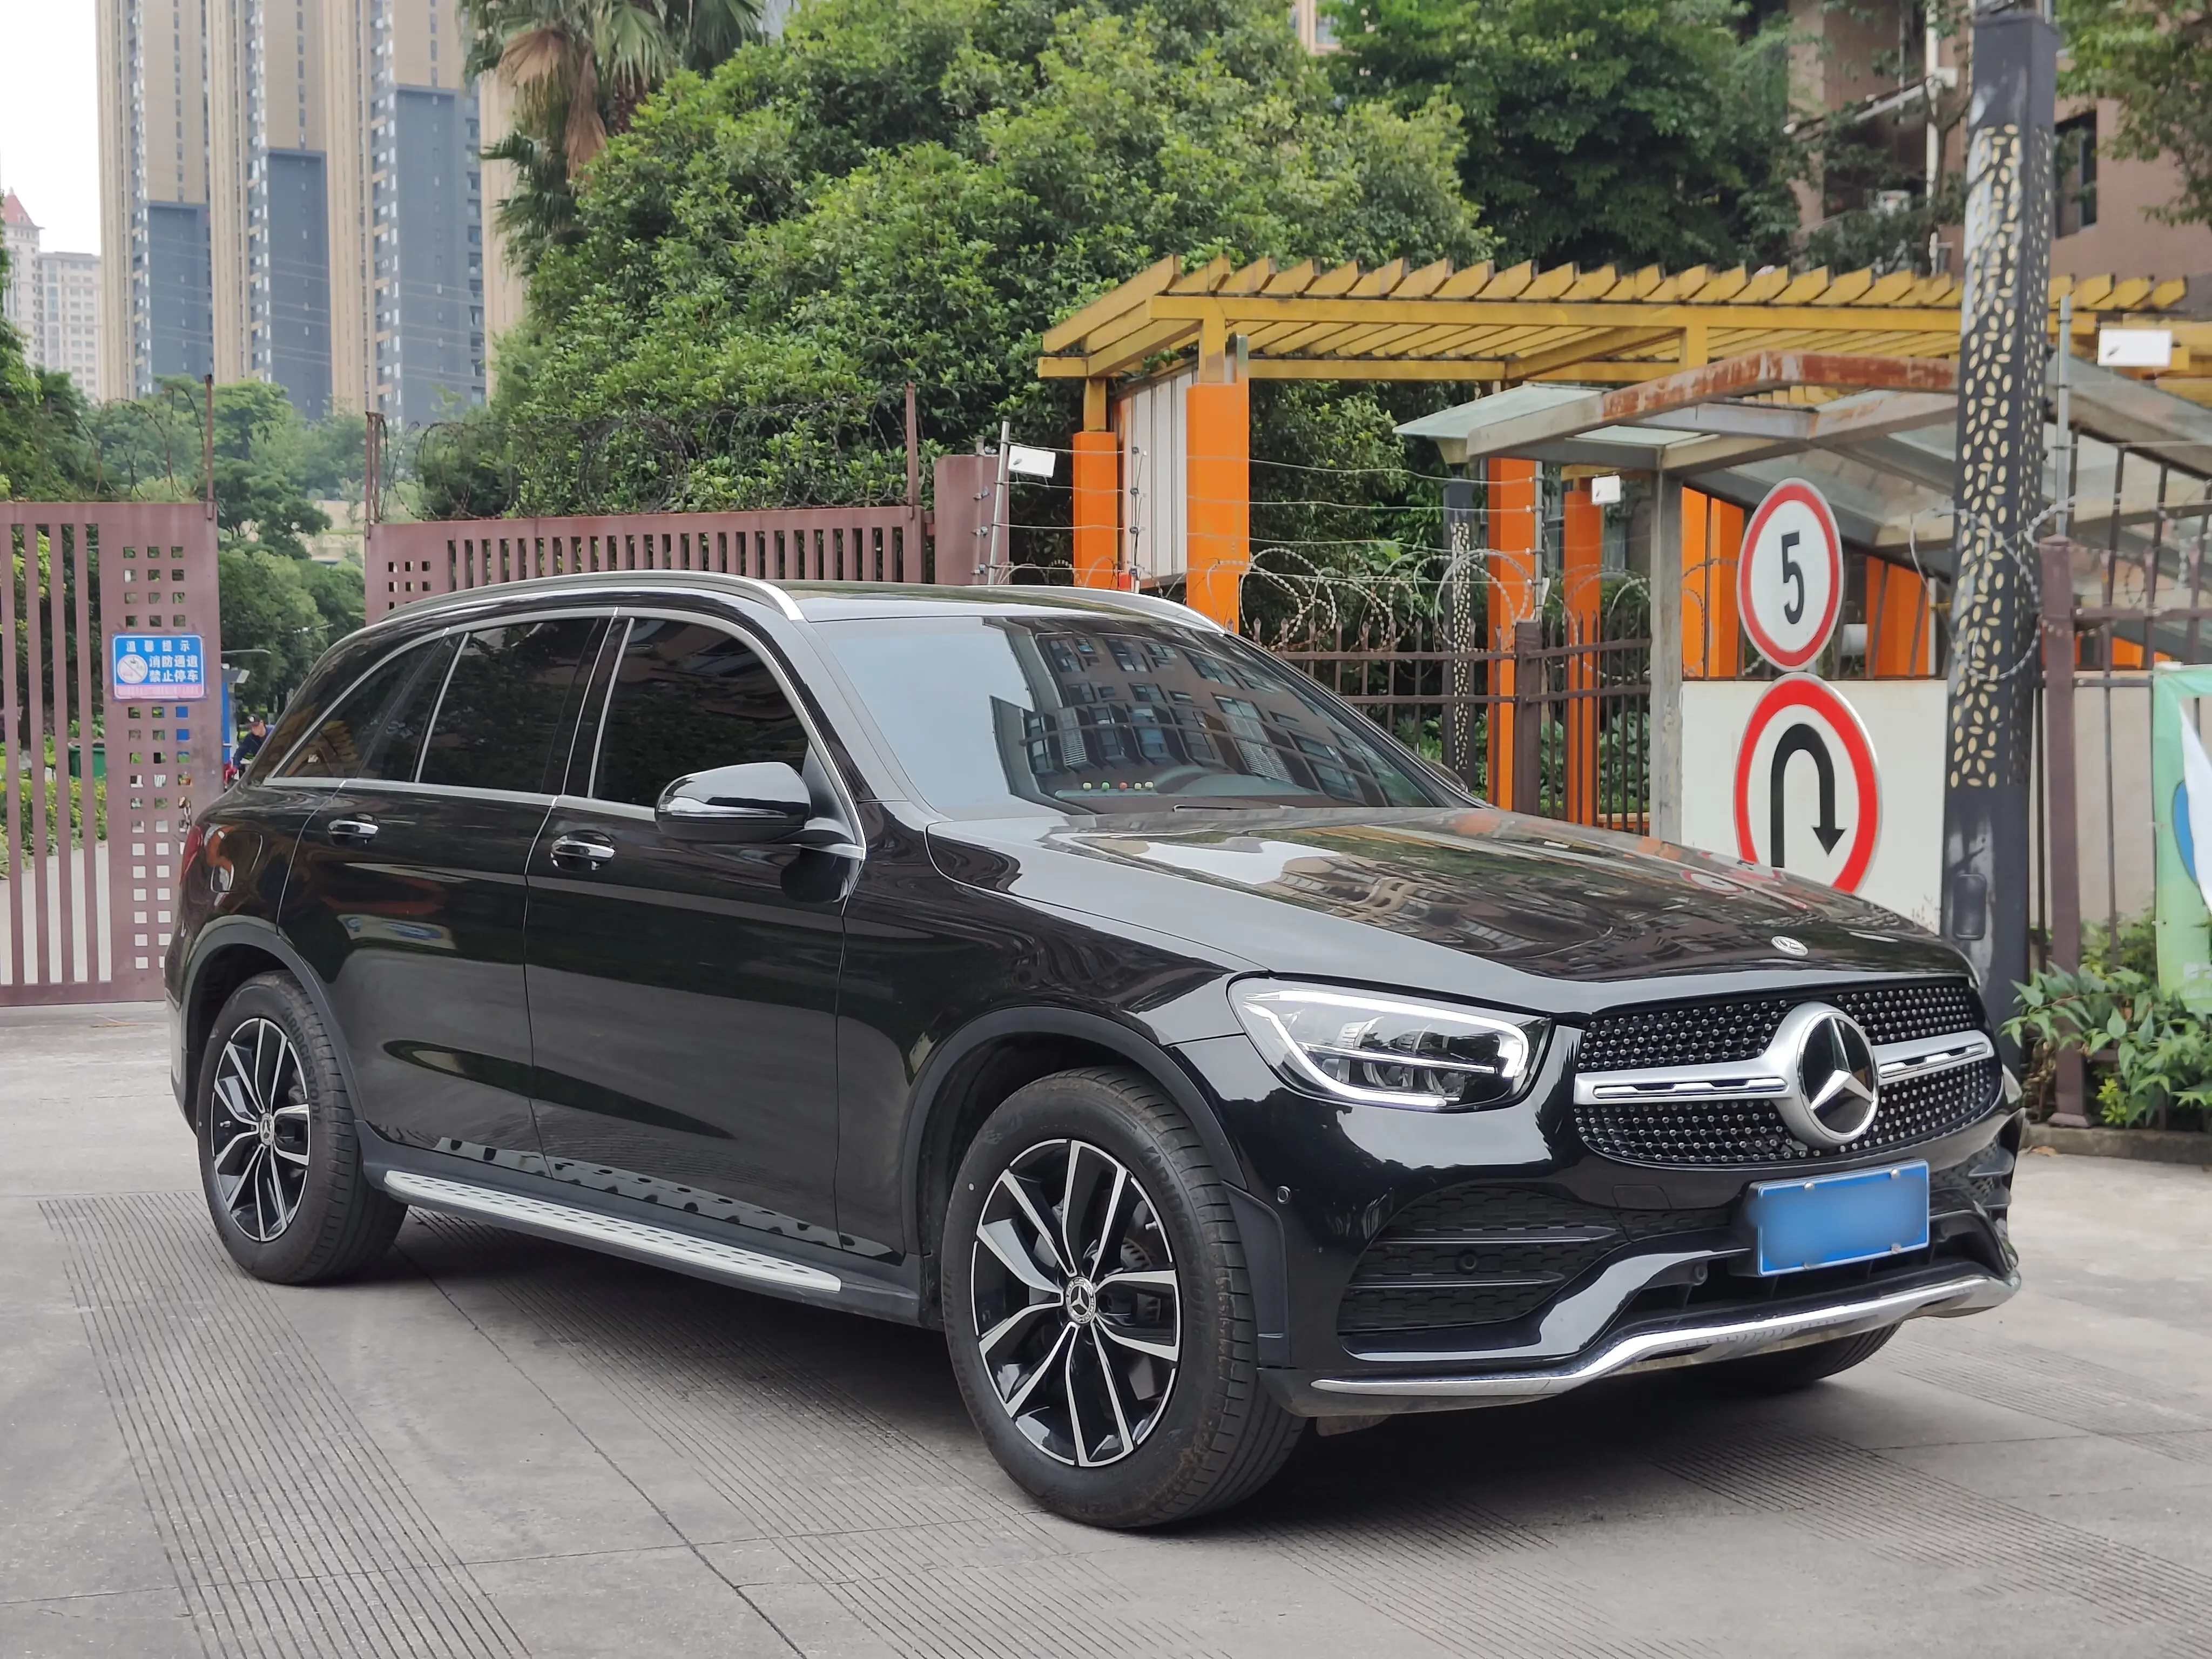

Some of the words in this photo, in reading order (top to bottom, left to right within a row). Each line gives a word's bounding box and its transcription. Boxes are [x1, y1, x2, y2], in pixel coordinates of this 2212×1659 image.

[1781, 530, 1804, 624] 5
[149, 655, 198, 667] 消防通道
[149, 670, 198, 683] 禁止停车
[280, 1007, 322, 1125] BRIDGESTONE
